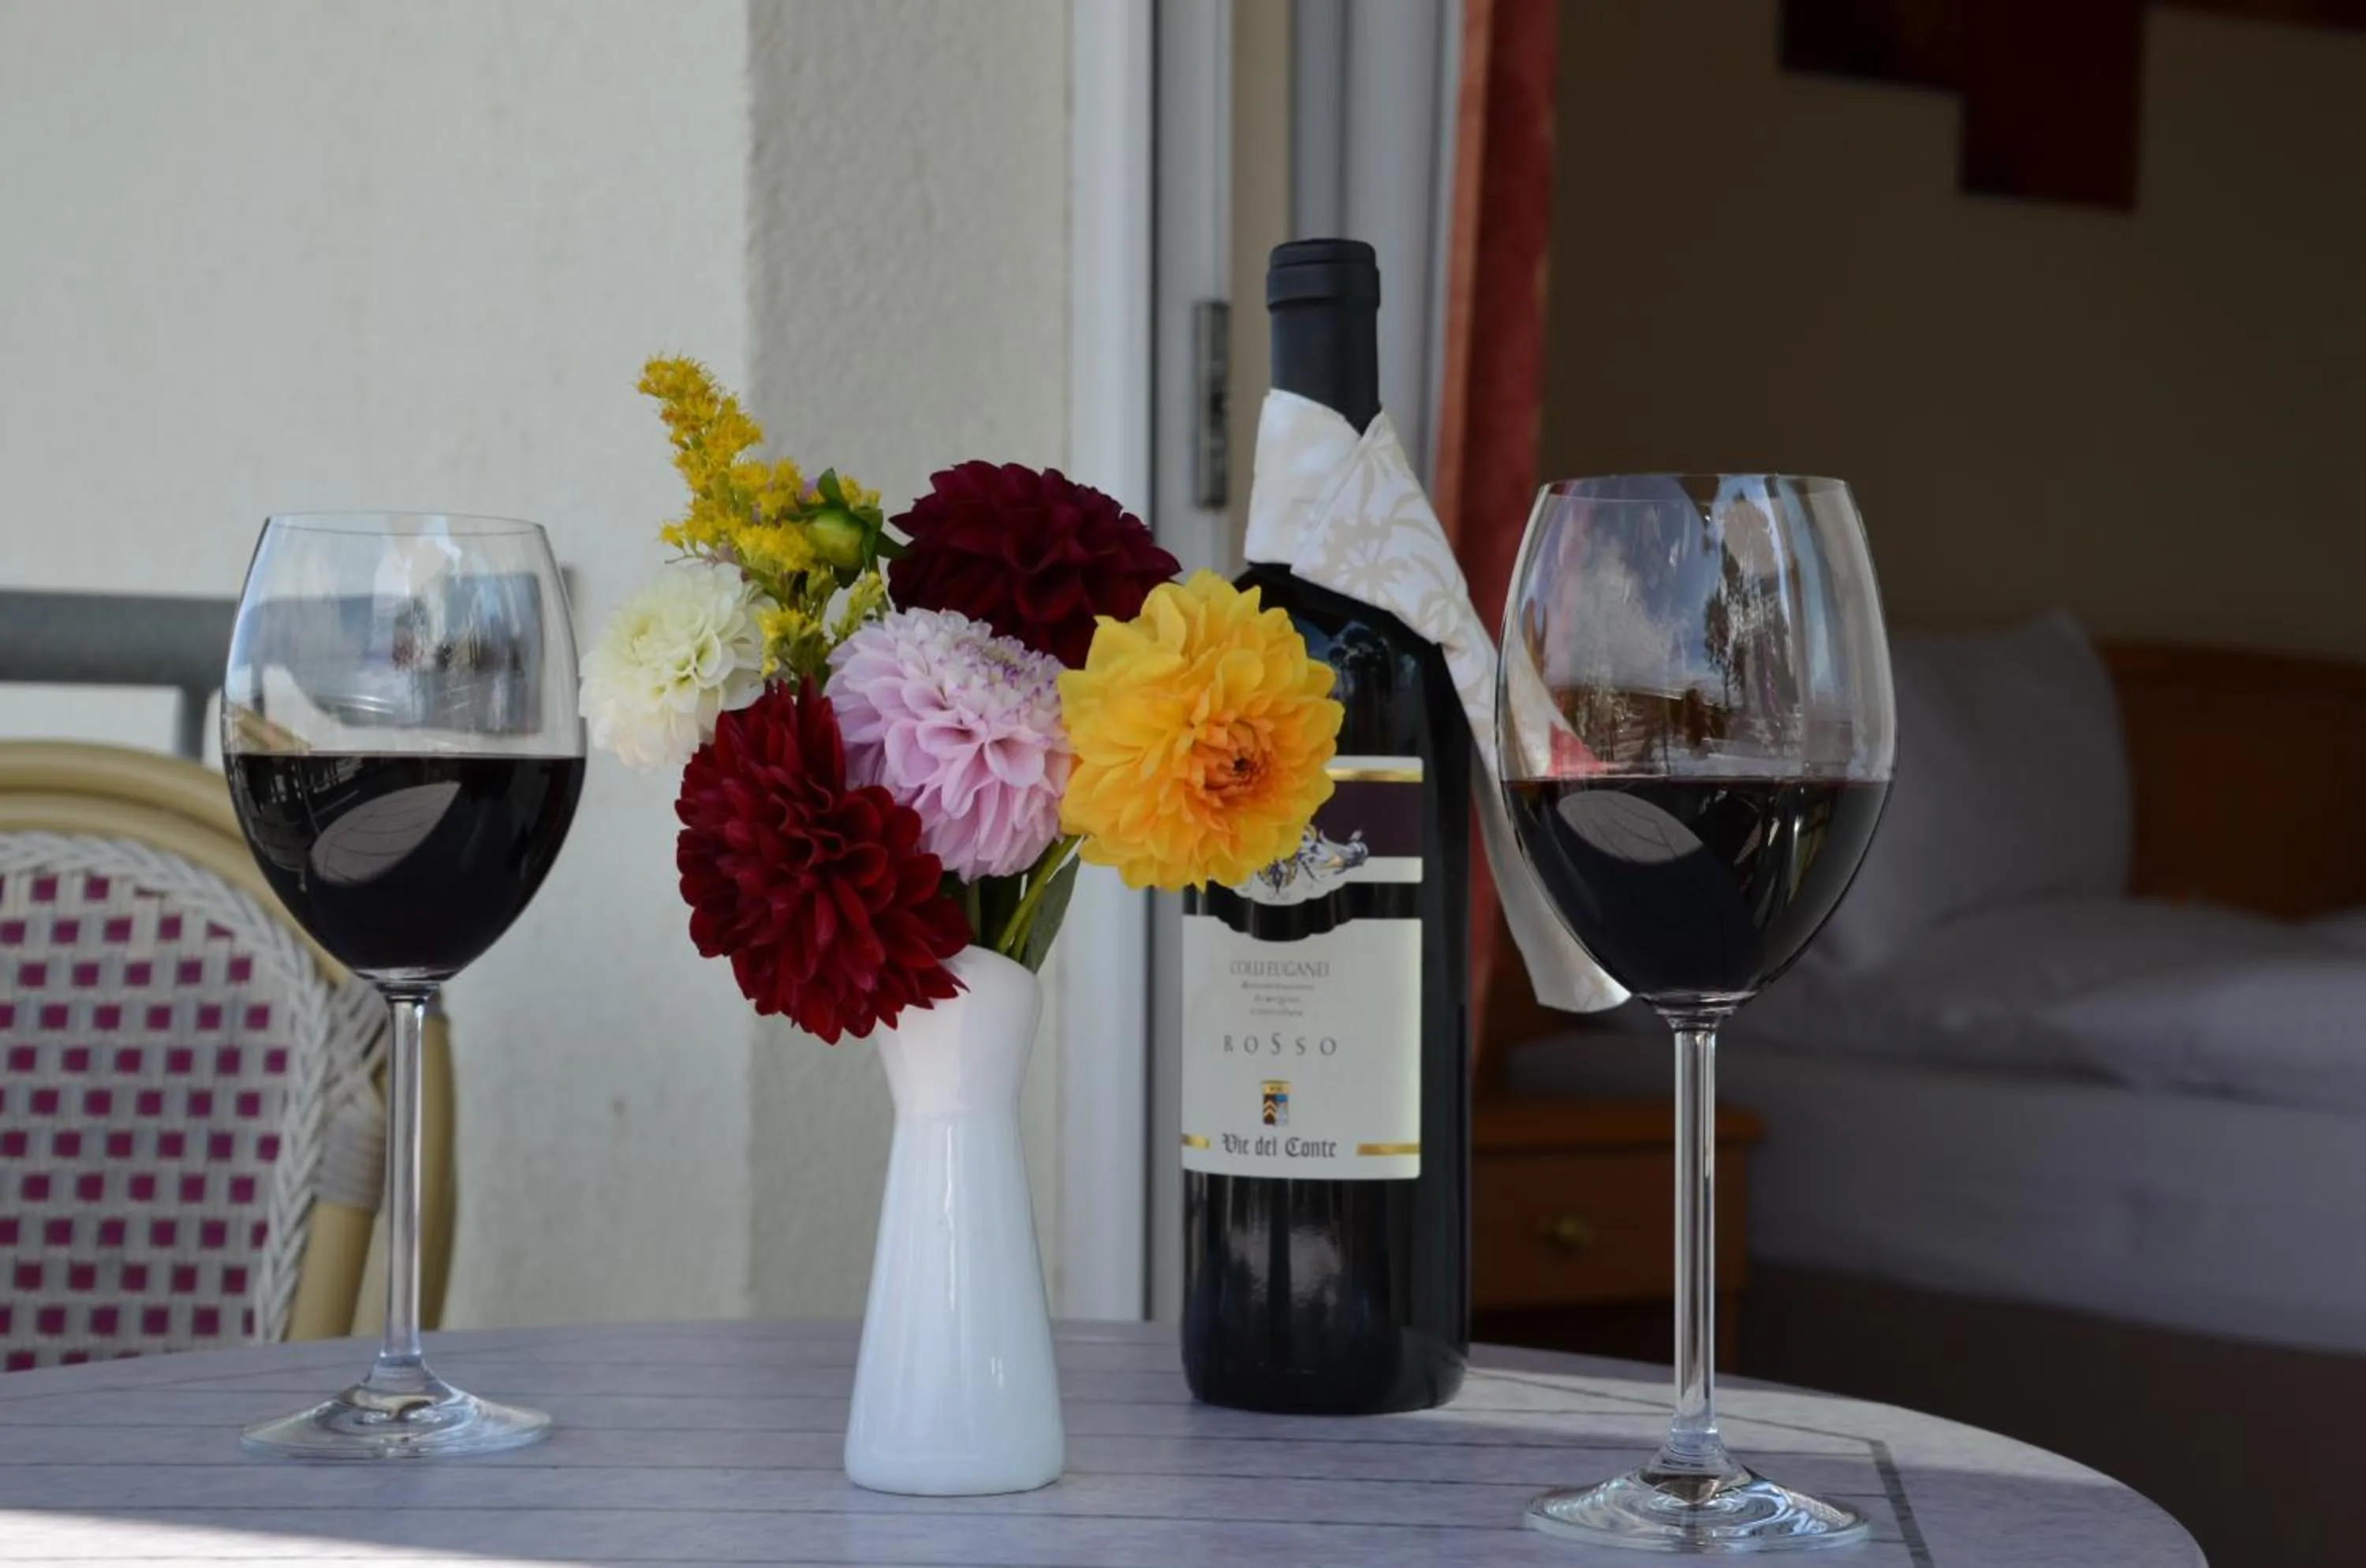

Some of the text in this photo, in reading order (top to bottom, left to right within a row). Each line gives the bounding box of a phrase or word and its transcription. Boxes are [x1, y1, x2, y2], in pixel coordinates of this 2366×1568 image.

[1223, 1032, 1338, 1056] ROSSO
[1222, 1133, 1338, 1158] Vie del Conte
